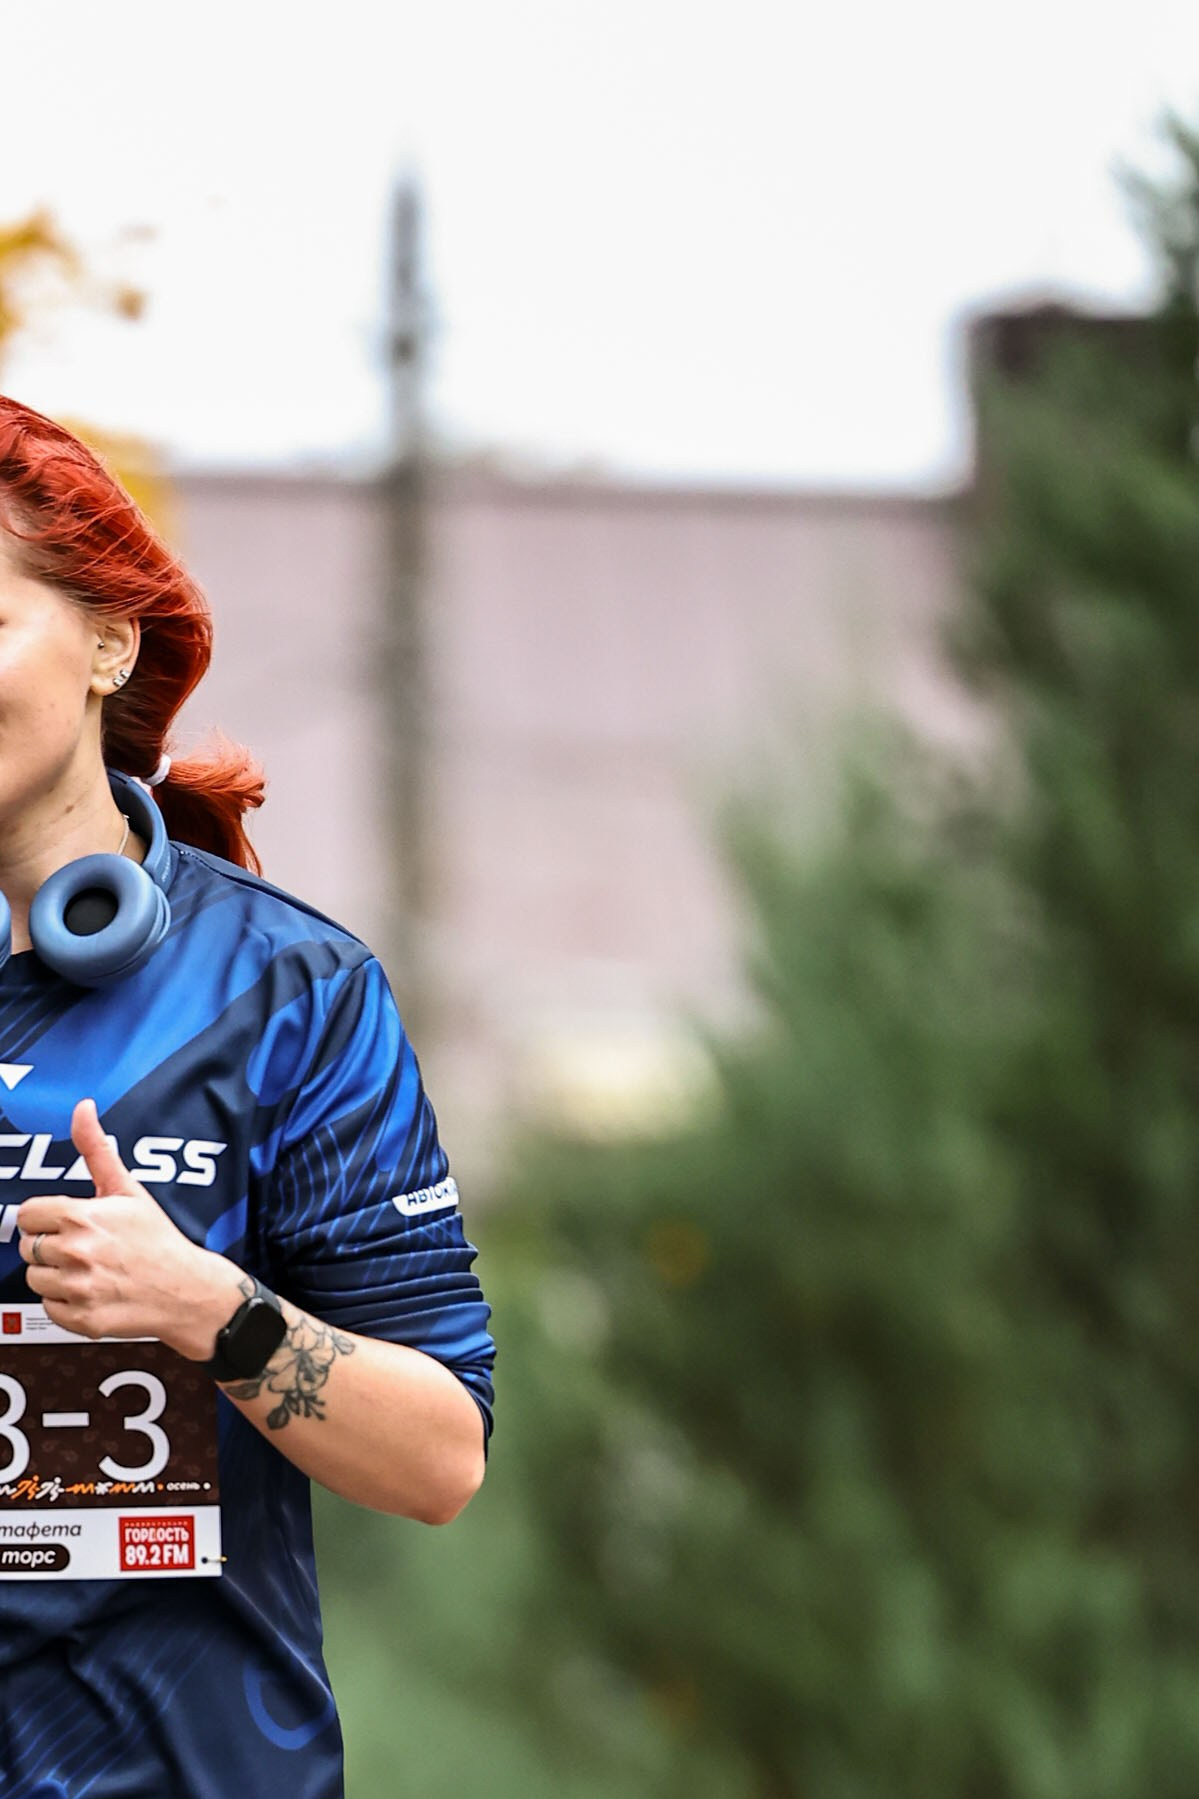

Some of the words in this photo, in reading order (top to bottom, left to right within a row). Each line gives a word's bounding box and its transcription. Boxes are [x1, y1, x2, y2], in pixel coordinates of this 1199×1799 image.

[166, 1481, 200, 1491] осень
[124, 1527, 189, 1543] ГОРДОСТЬ
[125, 1544, 161, 1566] 89.2
[163, 1543, 189, 1565] FM
